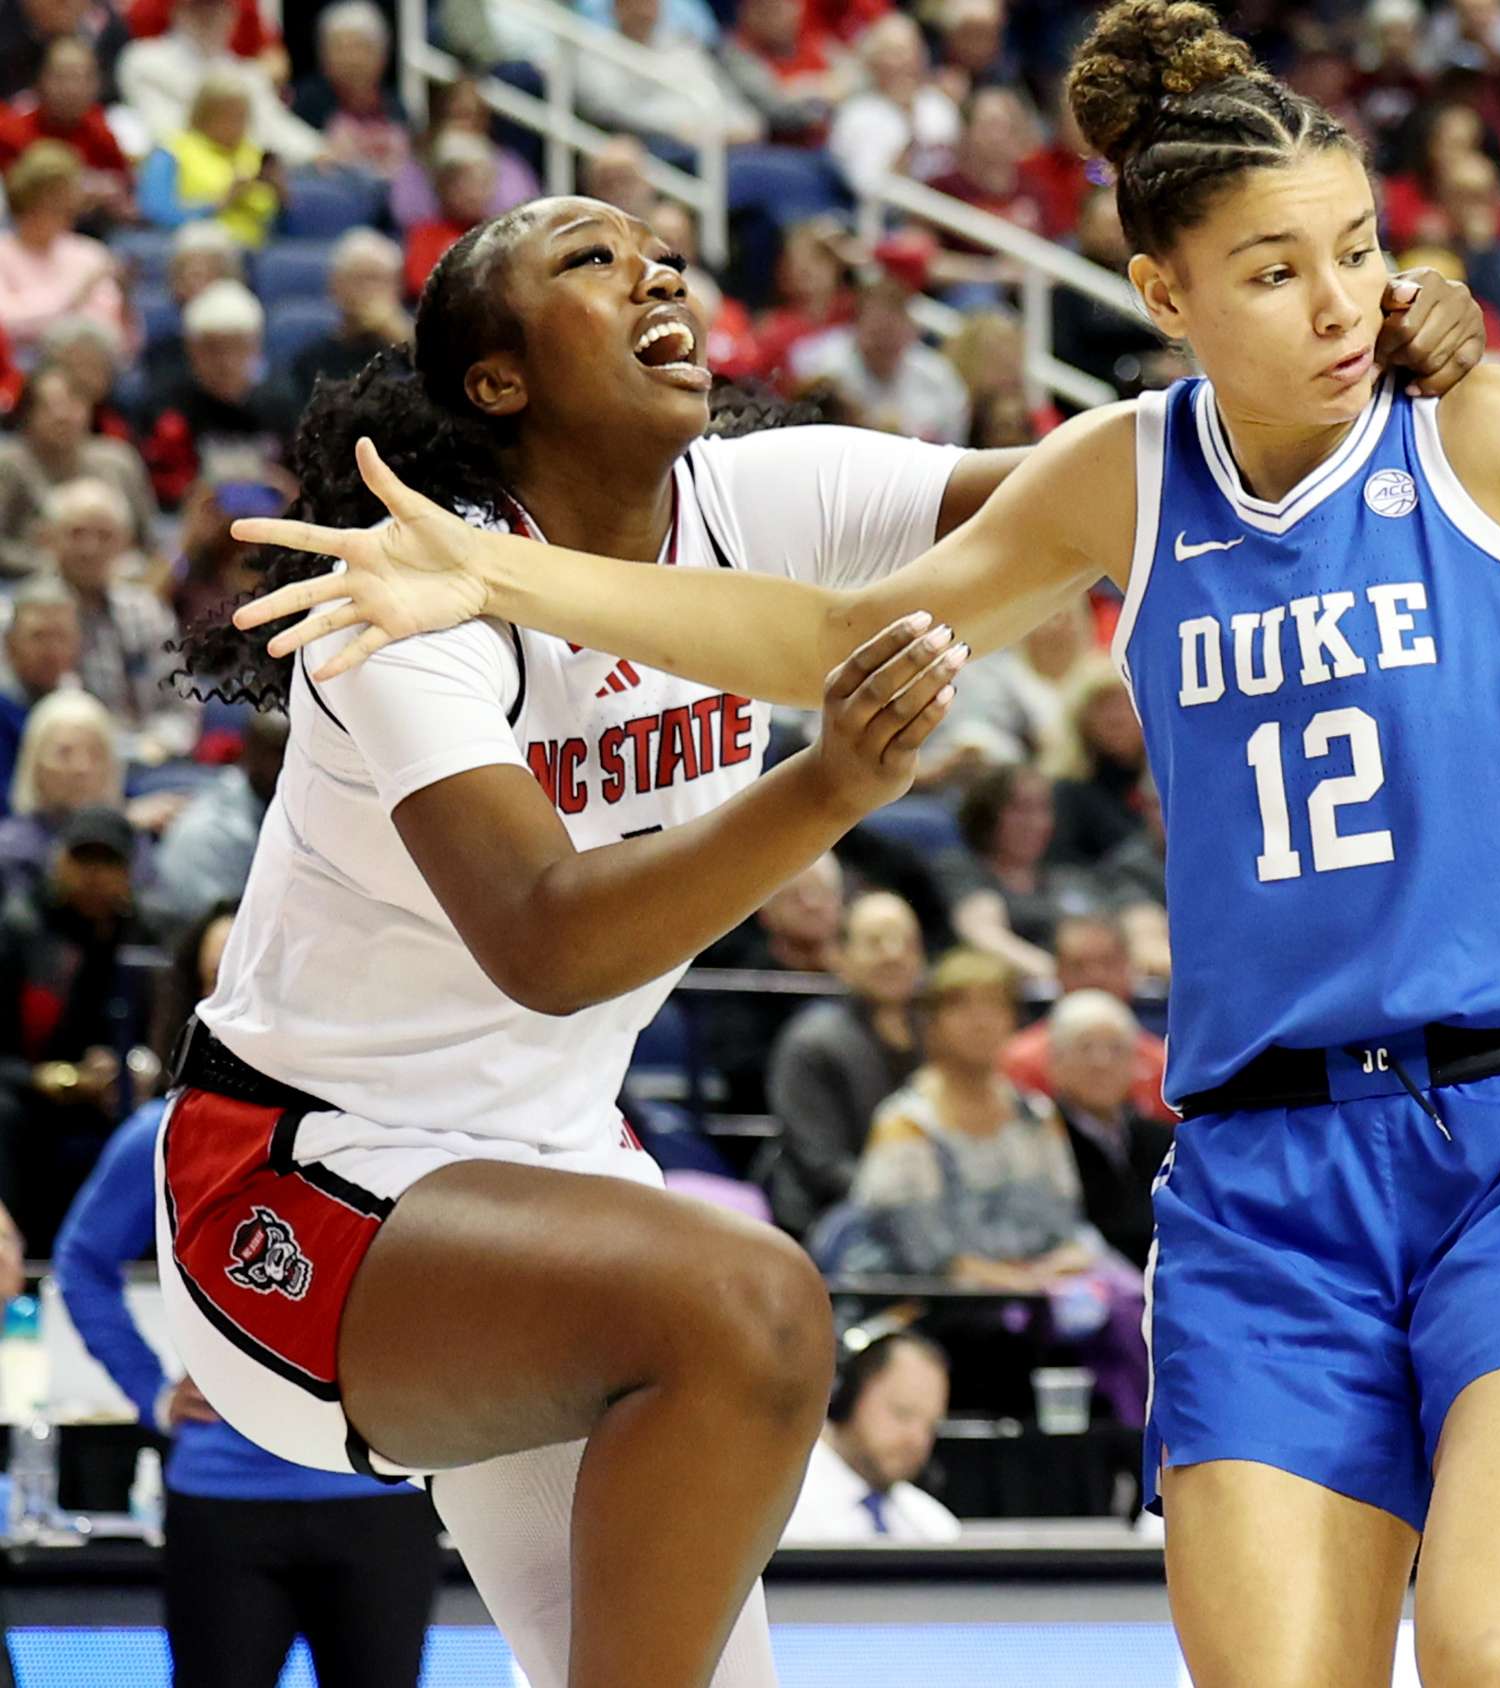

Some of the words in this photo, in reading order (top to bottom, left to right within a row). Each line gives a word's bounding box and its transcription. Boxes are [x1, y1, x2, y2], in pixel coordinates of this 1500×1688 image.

[1375, 482, 1412, 498] ACC
[1178, 582, 1437, 708] DUKE
[526, 737, 589, 816] NC
[599, 692, 752, 805] STATE
[1247, 706, 1395, 883] 12
[1362, 1047, 1390, 1074] JC
